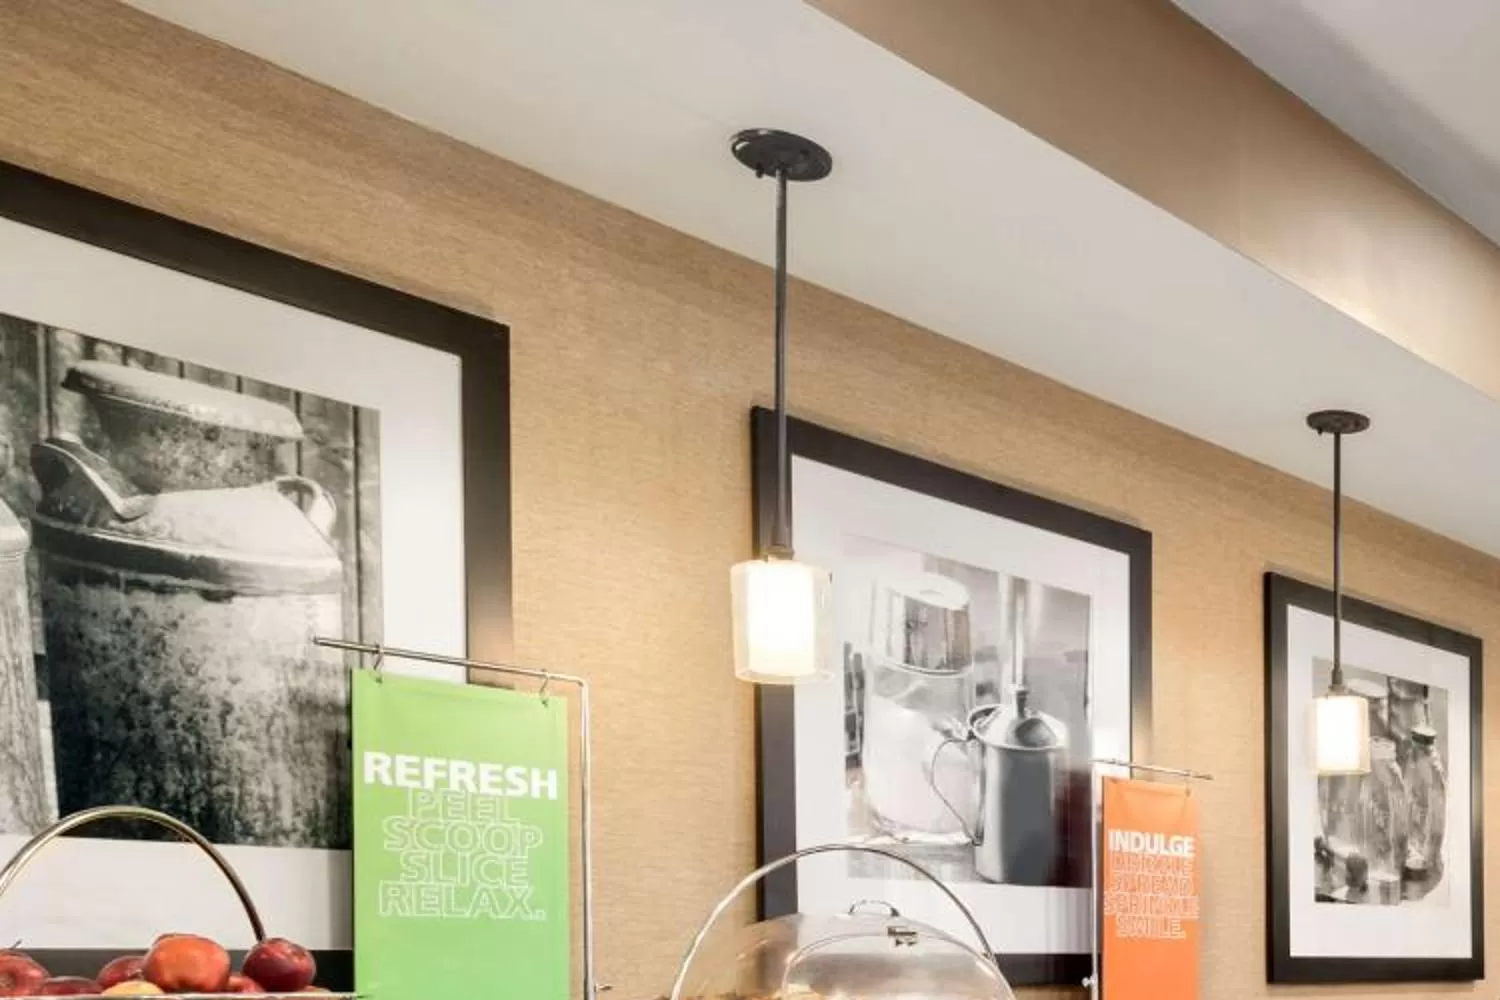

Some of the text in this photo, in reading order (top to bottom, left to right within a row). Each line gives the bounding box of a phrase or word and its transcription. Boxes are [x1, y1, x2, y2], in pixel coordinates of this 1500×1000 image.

[363, 751, 558, 801] REFRESH
[407, 786, 522, 828] PEEL
[382, 815, 544, 857] SCOOP
[1108, 831, 1195, 857] INDULGE
[399, 849, 530, 889] SLICE
[378, 879, 547, 921] RELAX.
